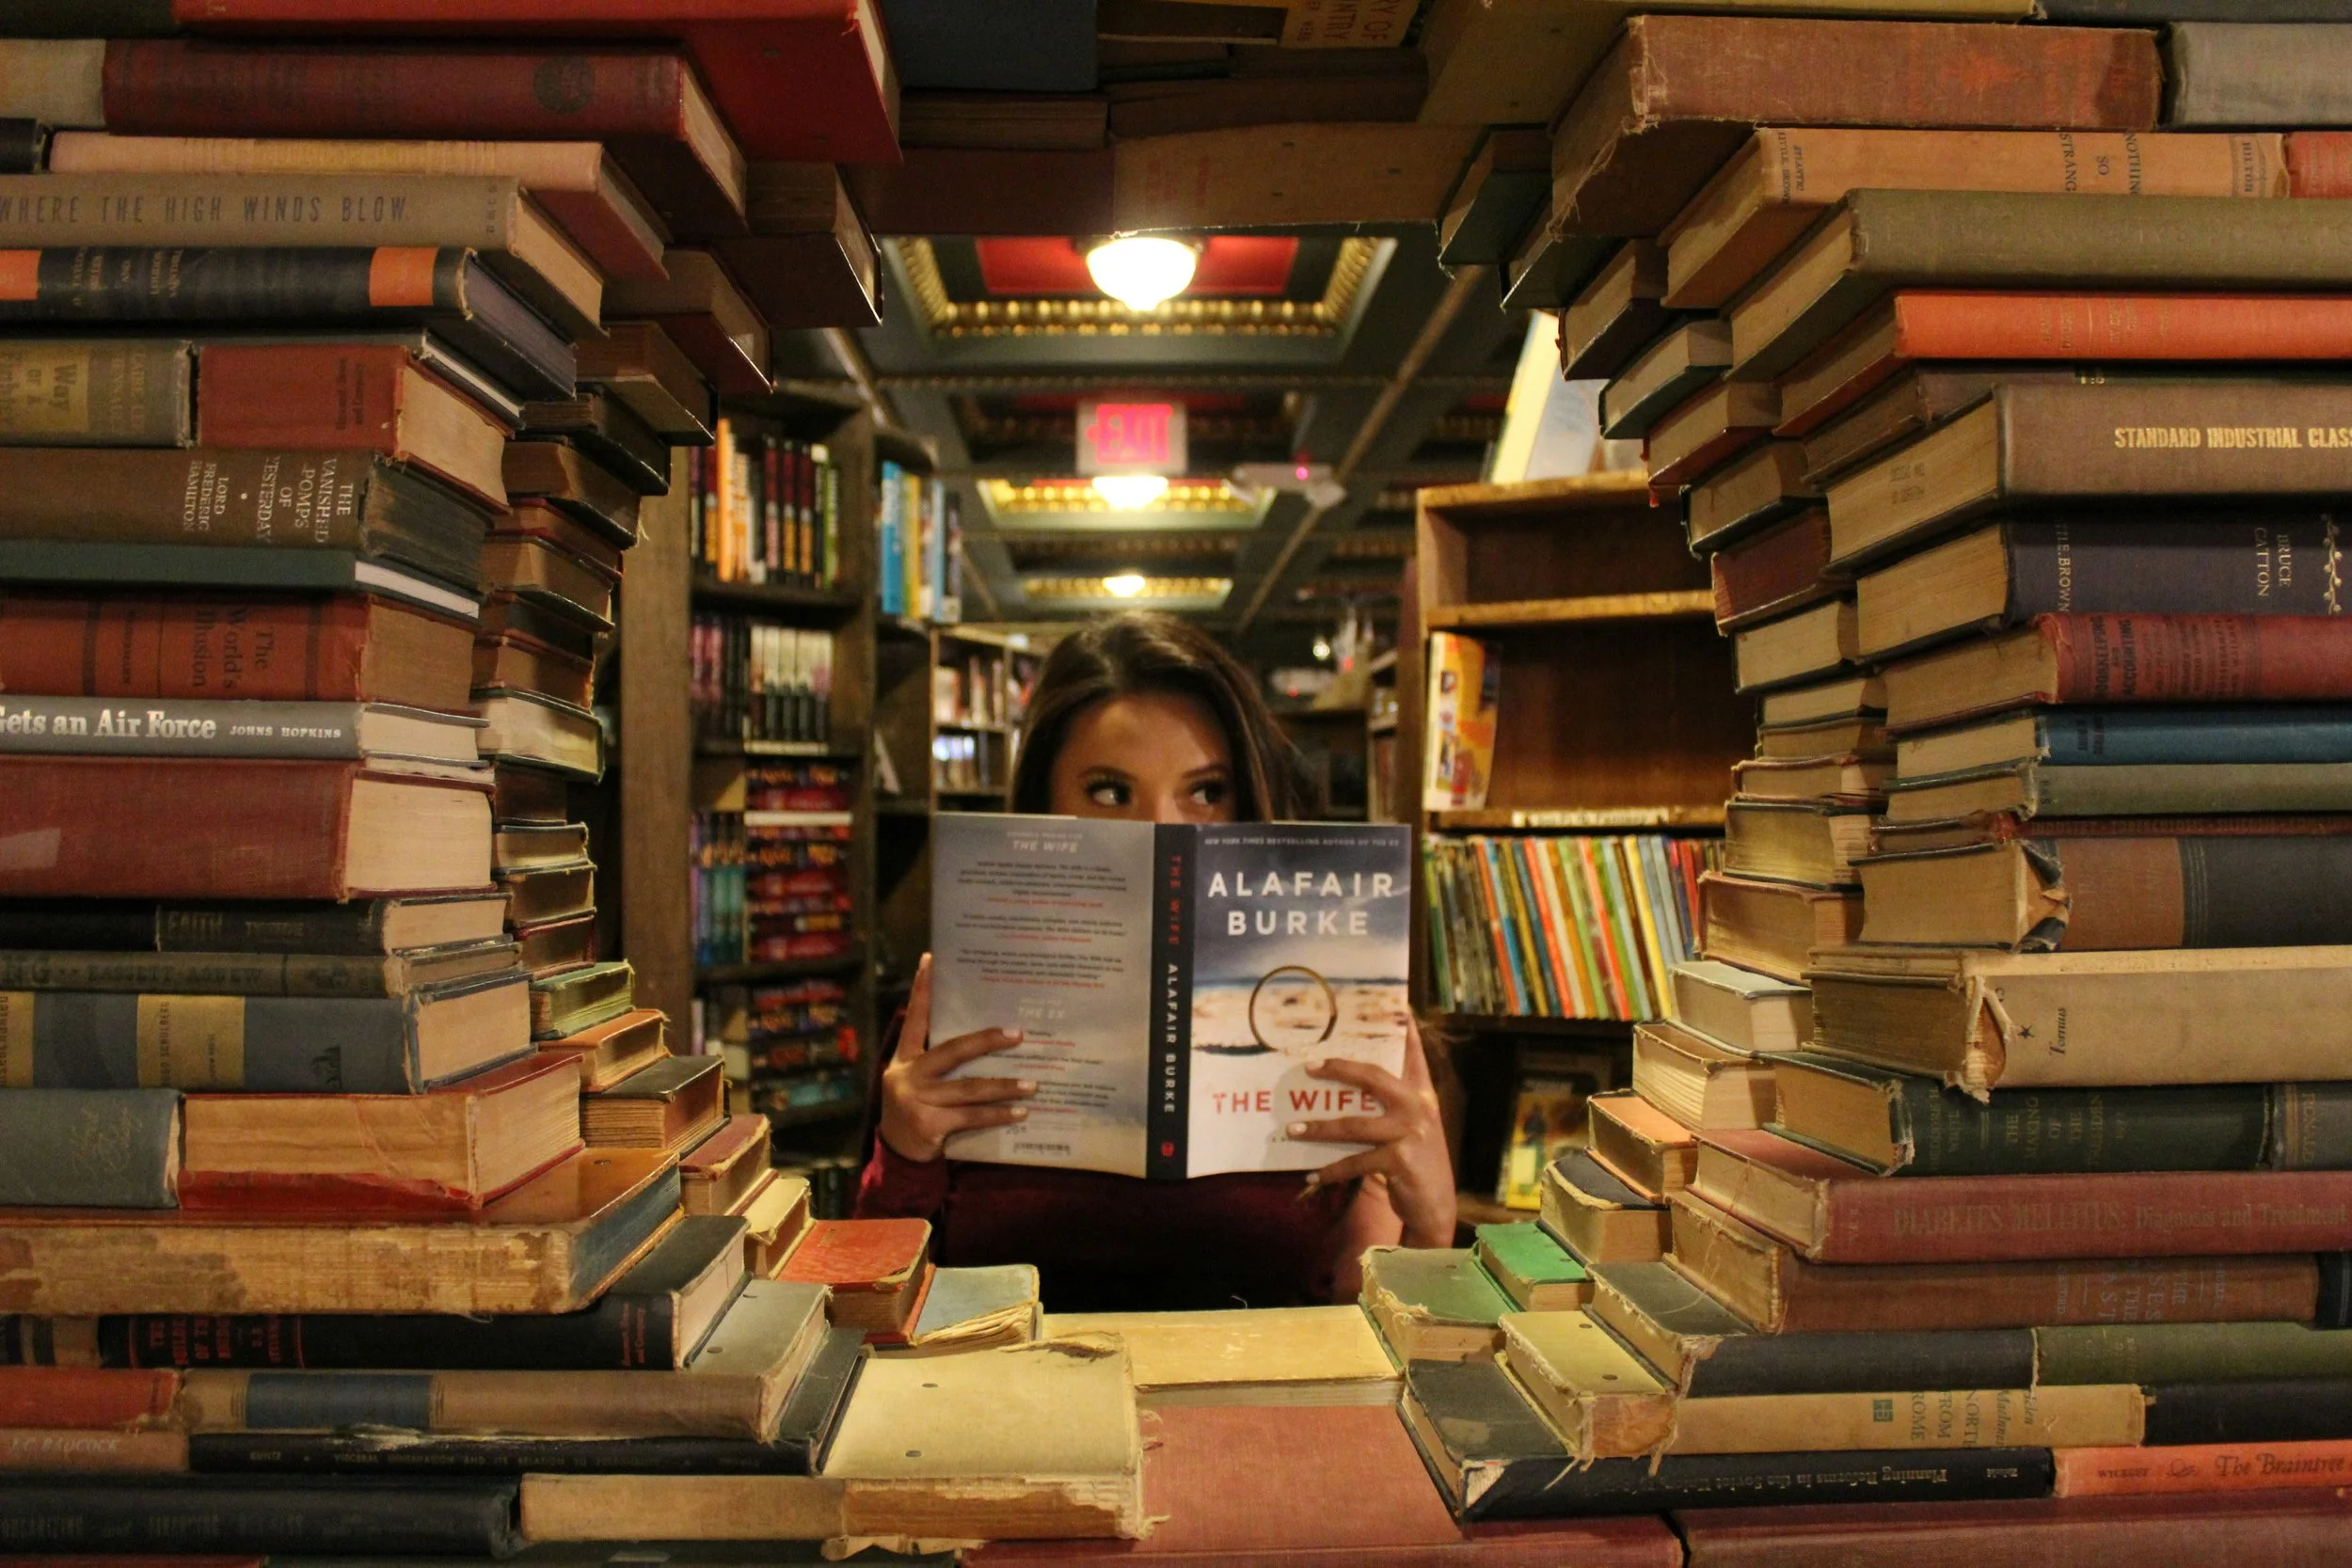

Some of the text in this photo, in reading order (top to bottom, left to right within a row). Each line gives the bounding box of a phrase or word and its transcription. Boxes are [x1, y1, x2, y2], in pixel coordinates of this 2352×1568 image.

[1361, 21, 1392, 40] OF
[2059, 134, 2077, 192] STRANG
[2097, 155, 2109, 176] SO
[2242, 142, 2253, 193] HILTON
[0, 195, 80, 225] WHERE
[98, 195, 144, 224] THE
[165, 195, 223, 223] HIGH
[243, 195, 322, 223] WINDS
[2115, 428, 2201, 449] STANDARD
[2207, 427, 2302, 448] INDUSTRIAL
[199, 460, 216, 532] FREDERIC
[215, 476, 229, 515] LORD
[280, 485, 293, 508] OF
[314, 457, 338, 545] VANISHED
[336, 483, 354, 516] THE
[2255, 527, 2270, 596] CATTON
[2278, 533, 2292, 587] BRUCE
[2058, 557, 2071, 612] BROWN
[192, 609, 215, 689] Illusion
[220, 605, 253, 690] World's
[255, 625, 277, 672] The
[53, 713, 87, 736] an
[95, 707, 142, 737] Air
[147, 709, 216, 740] Force
[230, 724, 273, 737] JOHNS
[281, 725, 342, 739] HOPKINS
[1012, 840, 1078, 853] THE WIFE
[1208, 871, 1394, 898] ALAFAIR
[1228, 911, 1369, 936] BURKE
[1164, 855, 1182, 1113] THE WIFE ALAFAIR BURKE
[1213, 1090, 1376, 1114] THE WIFE
[2006, 1115, 2020, 1144] THE
[2025, 1097, 2041, 1159] MAKING
[2048, 1117, 2061, 1139] OF
[2088, 1091, 2104, 1167] PRESIDEN
[2222, 1202, 2251, 1227] and
[2171, 1271, 2187, 1307] THE
[1910, 1390, 1928, 1441] ROME
[1936, 1390, 1953, 1439] FROM
[1797, 1473, 1812, 1488] in
[1817, 1470, 1879, 1487] Reforms
[1883, 1465, 1947, 1485] Planning
[2215, 1454, 2249, 1478] The
[2256, 1452, 2345, 1477] Braintree
[1716, 1475, 1763, 1491] Soviet
[1767, 1474, 1791, 1490] the
